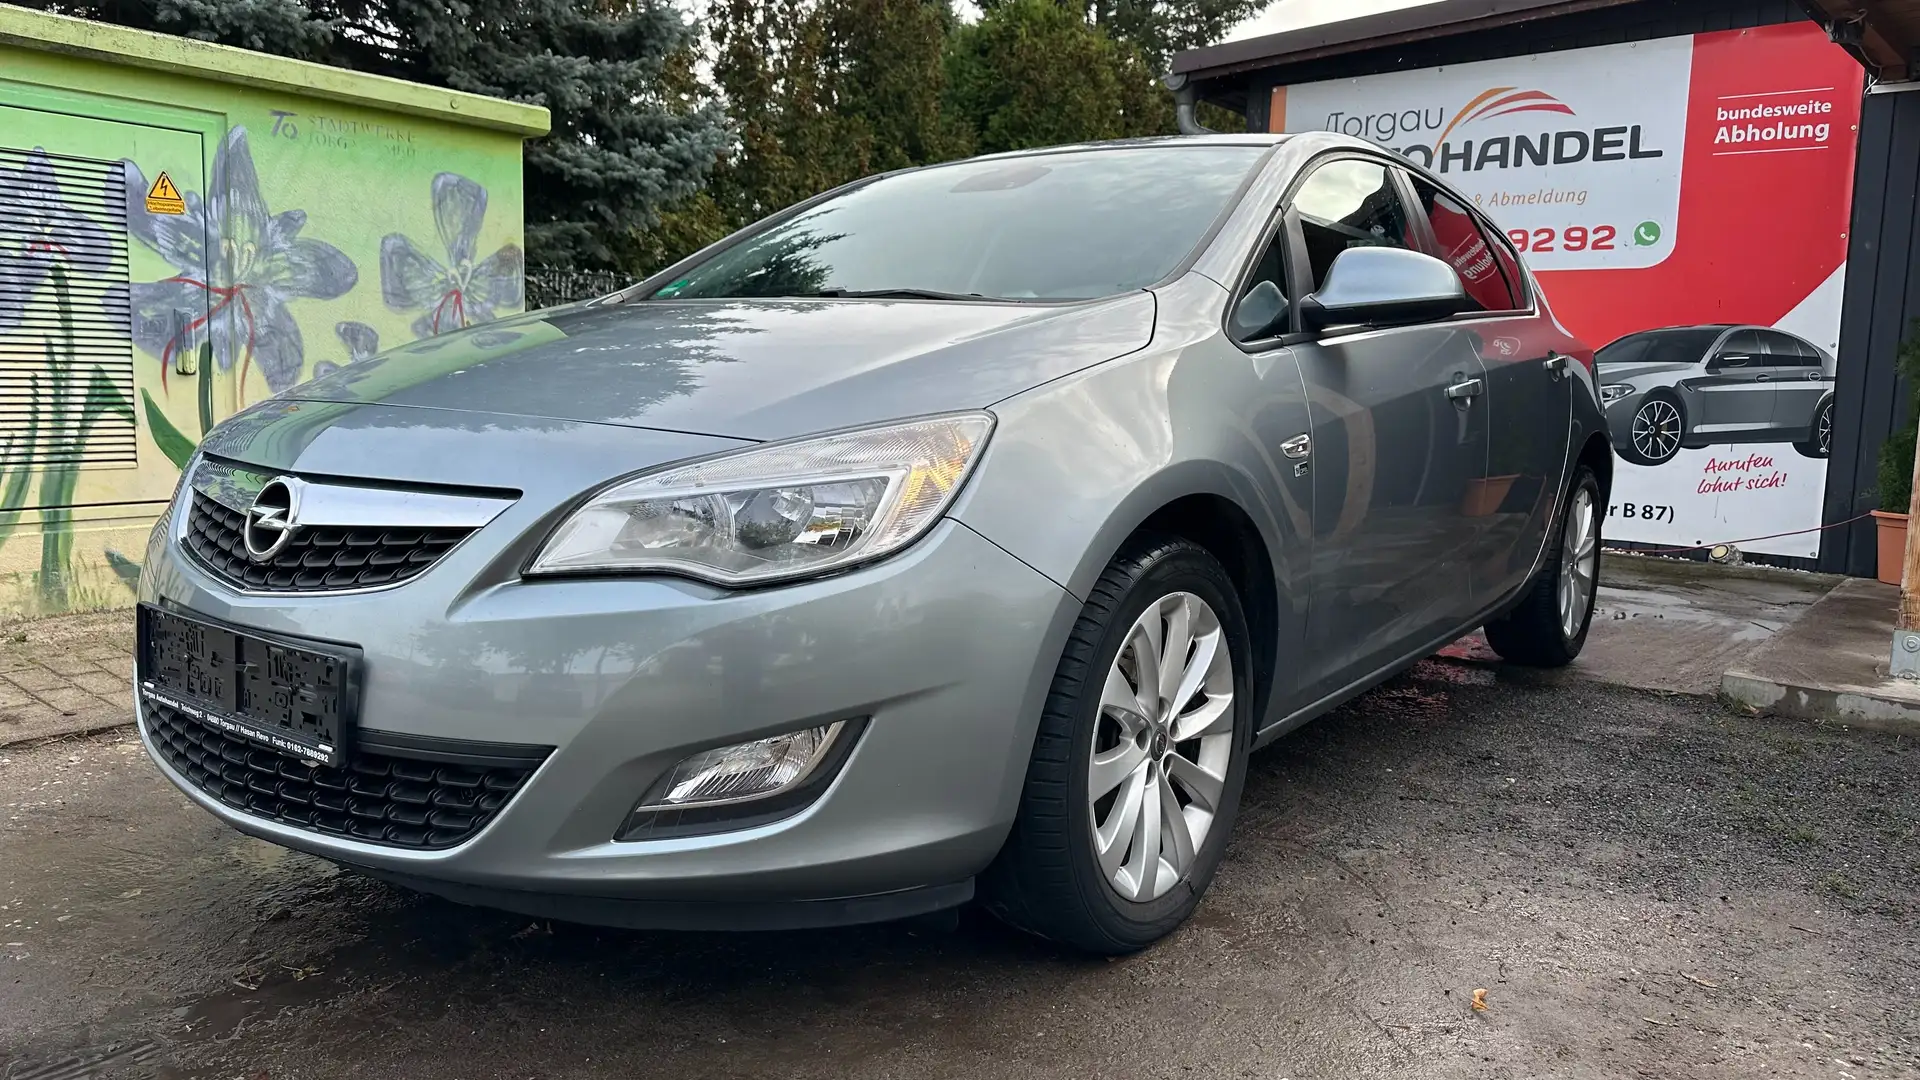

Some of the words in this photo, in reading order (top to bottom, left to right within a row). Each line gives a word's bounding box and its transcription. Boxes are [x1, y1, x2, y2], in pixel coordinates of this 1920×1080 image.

[1716, 99, 1832, 121] bundesweite
[1329, 107, 1444, 142] Torgau
[1713, 121, 1830, 145] Abholung
[1391, 124, 1664, 174] OHANDEL
[1488, 188, 1588, 207] Abmeldung
[1563, 225, 1617, 252] 92
[1704, 453, 1774, 474] Anrufen
[1745, 470, 1788, 490] sich!
[1623, 502, 1636, 518] B
[1641, 504, 1675, 524] 87)
